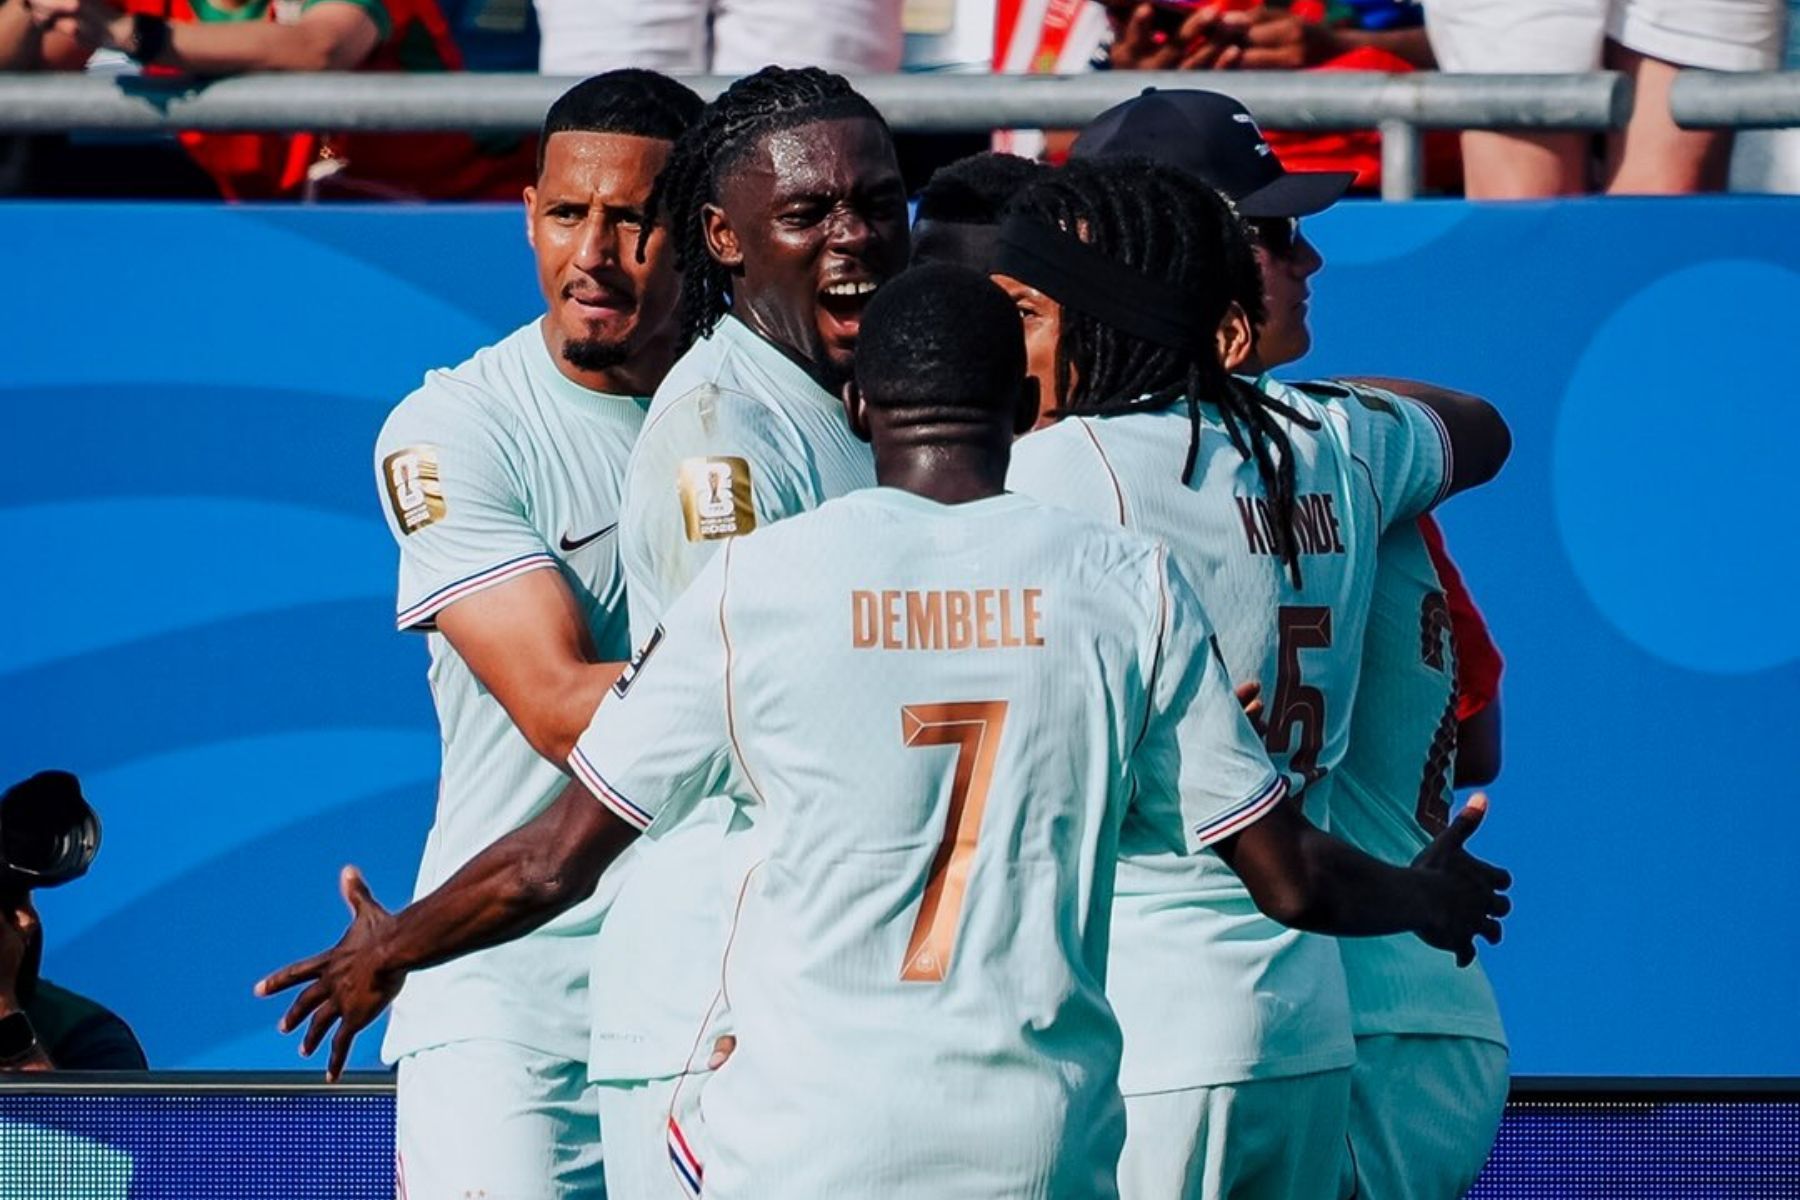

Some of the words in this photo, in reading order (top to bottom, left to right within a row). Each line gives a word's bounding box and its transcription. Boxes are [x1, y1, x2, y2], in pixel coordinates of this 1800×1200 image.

[1235, 493, 1346, 556] KONDE
[851, 588, 1045, 651] DEMBELE
[1265, 605, 1333, 785] 5
[900, 699, 1009, 983] 7
